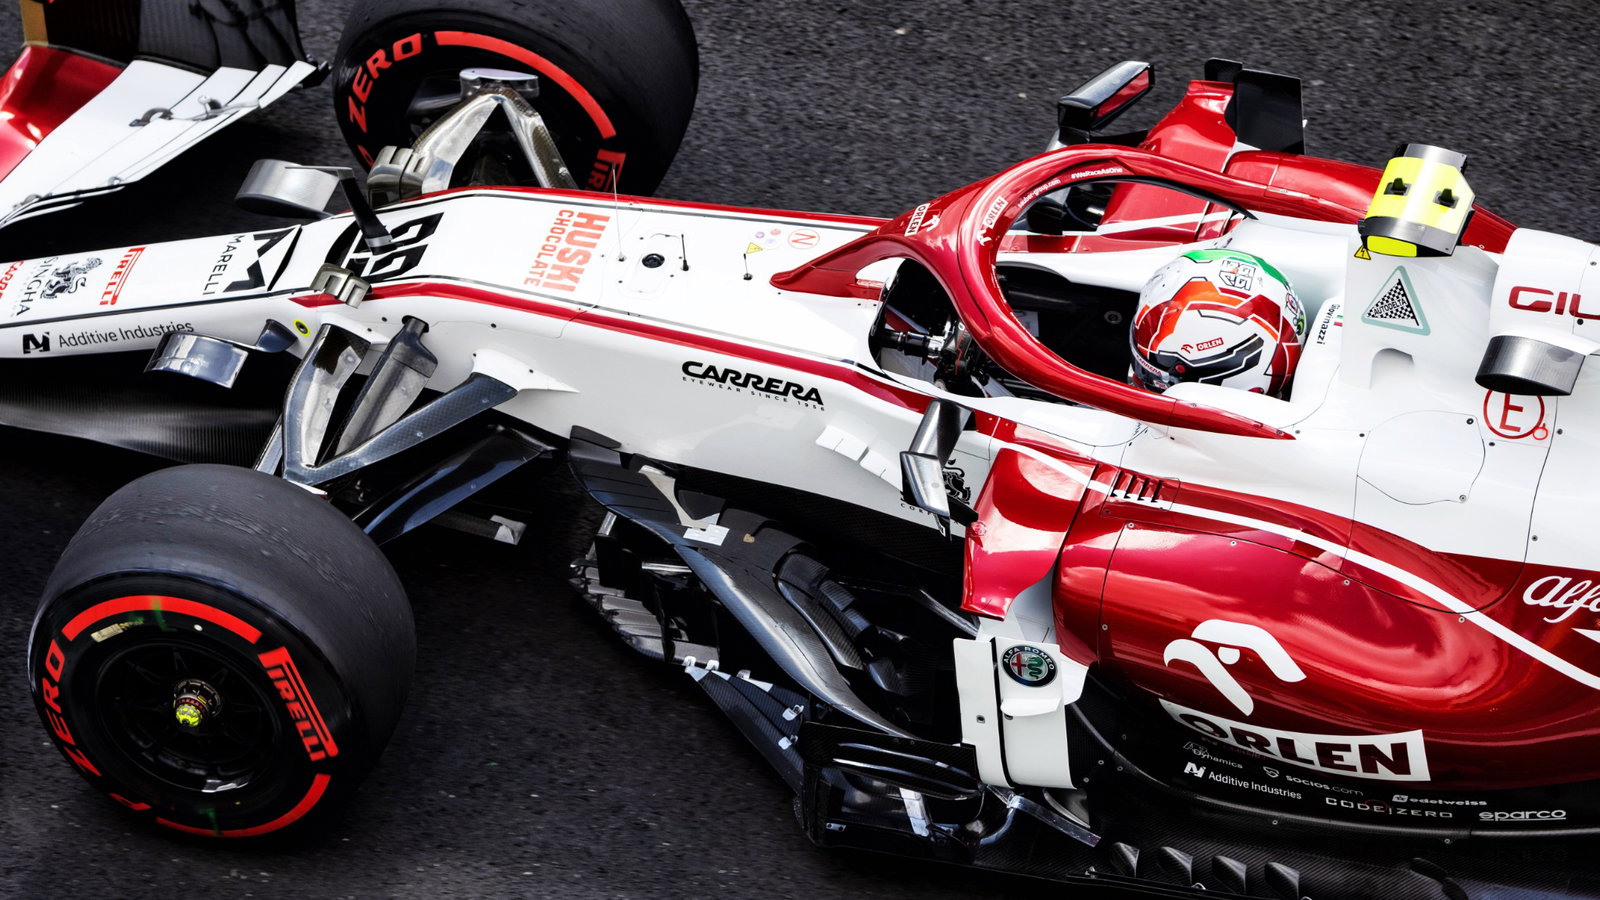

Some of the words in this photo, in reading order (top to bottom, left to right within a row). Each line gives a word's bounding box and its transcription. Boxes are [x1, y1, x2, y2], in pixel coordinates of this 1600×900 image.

[348, 32, 423, 134] ZERO
[907, 205, 927, 234] ORLEN
[986, 199, 1007, 226] ORLEN
[202, 235, 246, 295] MARELLI
[523, 209, 575, 287] CHOCOLATE
[541, 211, 611, 293] HUSKI
[16, 257, 59, 316] SINGHA
[99, 246, 147, 306] PIRELLI
[1316, 303, 1341, 345] Giovinazzi
[1373, 298, 1408, 316] AUTODELTA
[58, 331, 117, 348] Additive
[1197, 338, 1223, 351] ORLEN
[681, 360, 824, 406] CARRERA
[682, 376, 741, 393] EYEWEAR
[751, 390, 788, 403] SINCE
[797, 400, 825, 412] 1956
[1003, 647, 1021, 664] ALFA
[1024, 646, 1055, 670] ROMEO
[42, 638, 103, 777] ZERO
[257, 646, 339, 762] PIRELLI
[1178, 713, 1412, 776] ORLEN
[1208, 771, 1249, 789] Additive
[1251, 781, 1302, 800] Industries
[1408, 796, 1488, 807] edelweiss
[1478, 809, 1567, 822] sparco
